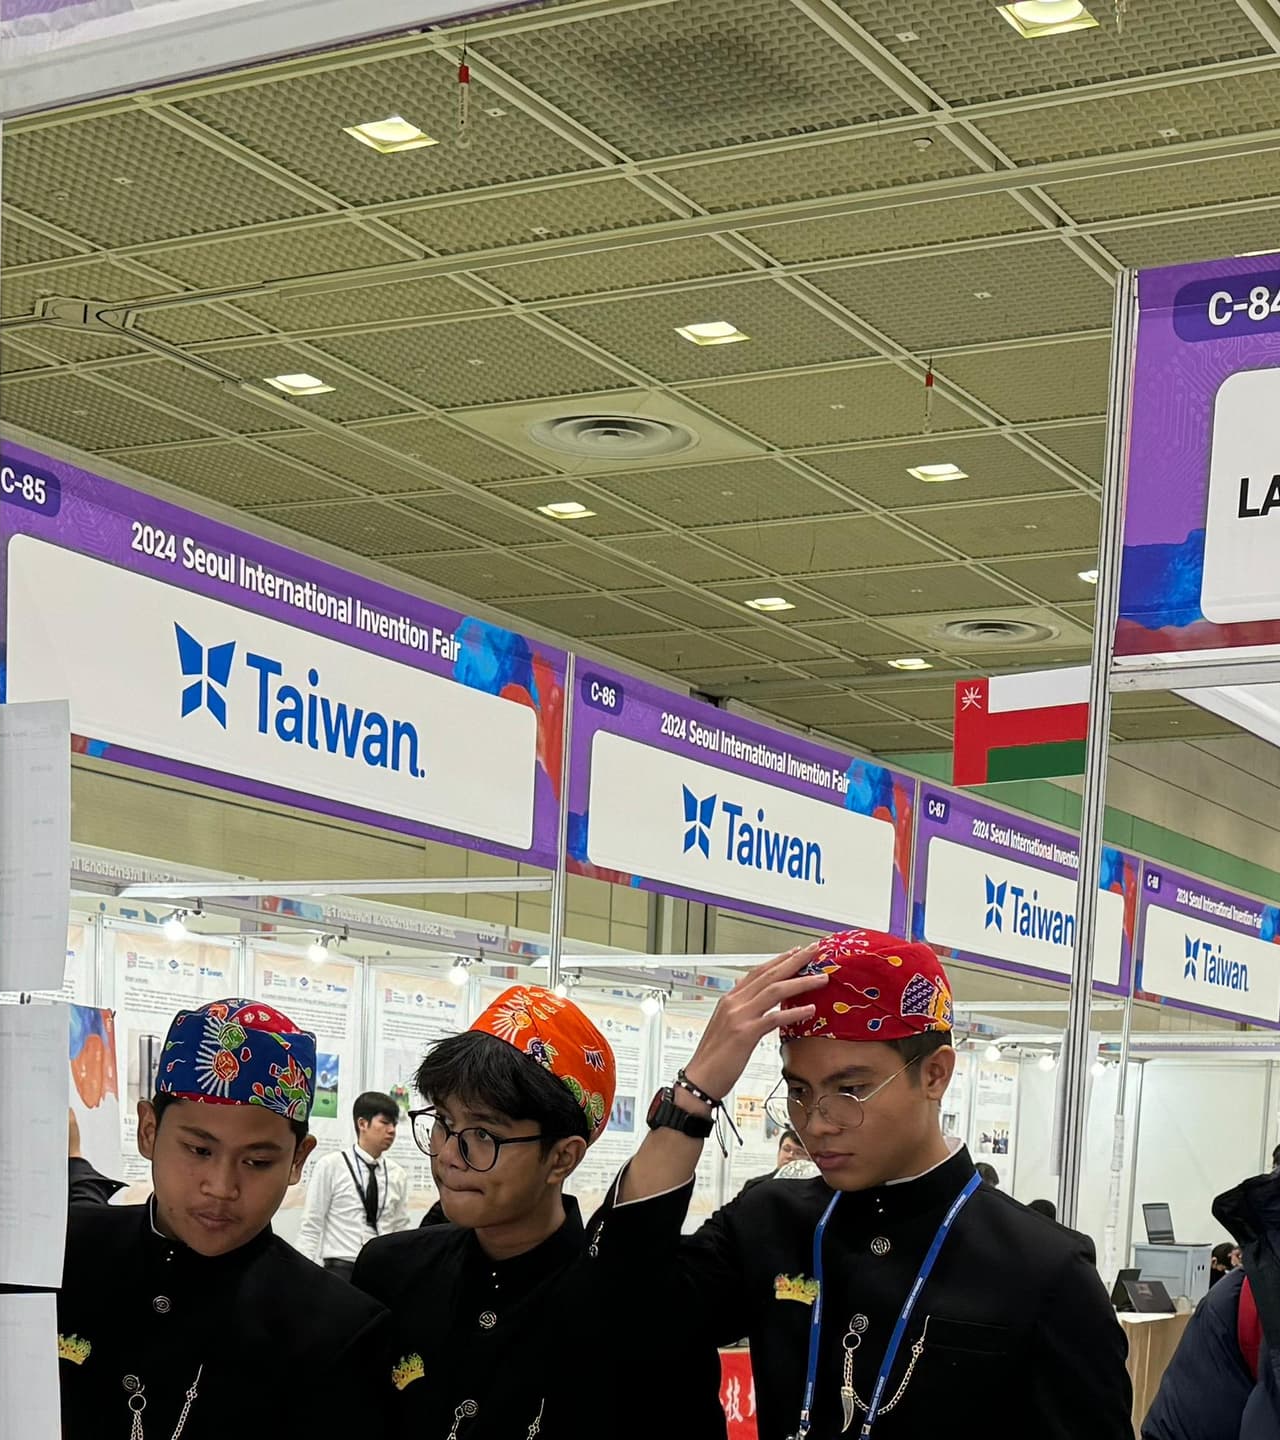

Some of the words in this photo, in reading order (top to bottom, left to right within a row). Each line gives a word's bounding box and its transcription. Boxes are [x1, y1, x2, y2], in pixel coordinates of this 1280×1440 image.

[0, 465, 47, 505] C-85
[131, 521, 177, 563] 2024
[182, 536, 236, 584] Seoul
[239, 556, 352, 625] International
[355, 599, 429, 652] Invention
[432, 628, 462, 663] Fair
[590, 681, 617, 708] C-86
[660, 712, 687, 742] 2024
[688, 719, 720, 754] Seoul
[721, 732, 786, 774] International
[787, 754, 832, 790] Invention
[832, 769, 849, 794] Fair
[928, 800, 946, 818] C-87
[972, 819, 989, 840] 2024
[990, 824, 1010, 847] Seoul
[1010, 829, 1053, 861] International
[1053, 845, 1079, 869] Inventio
